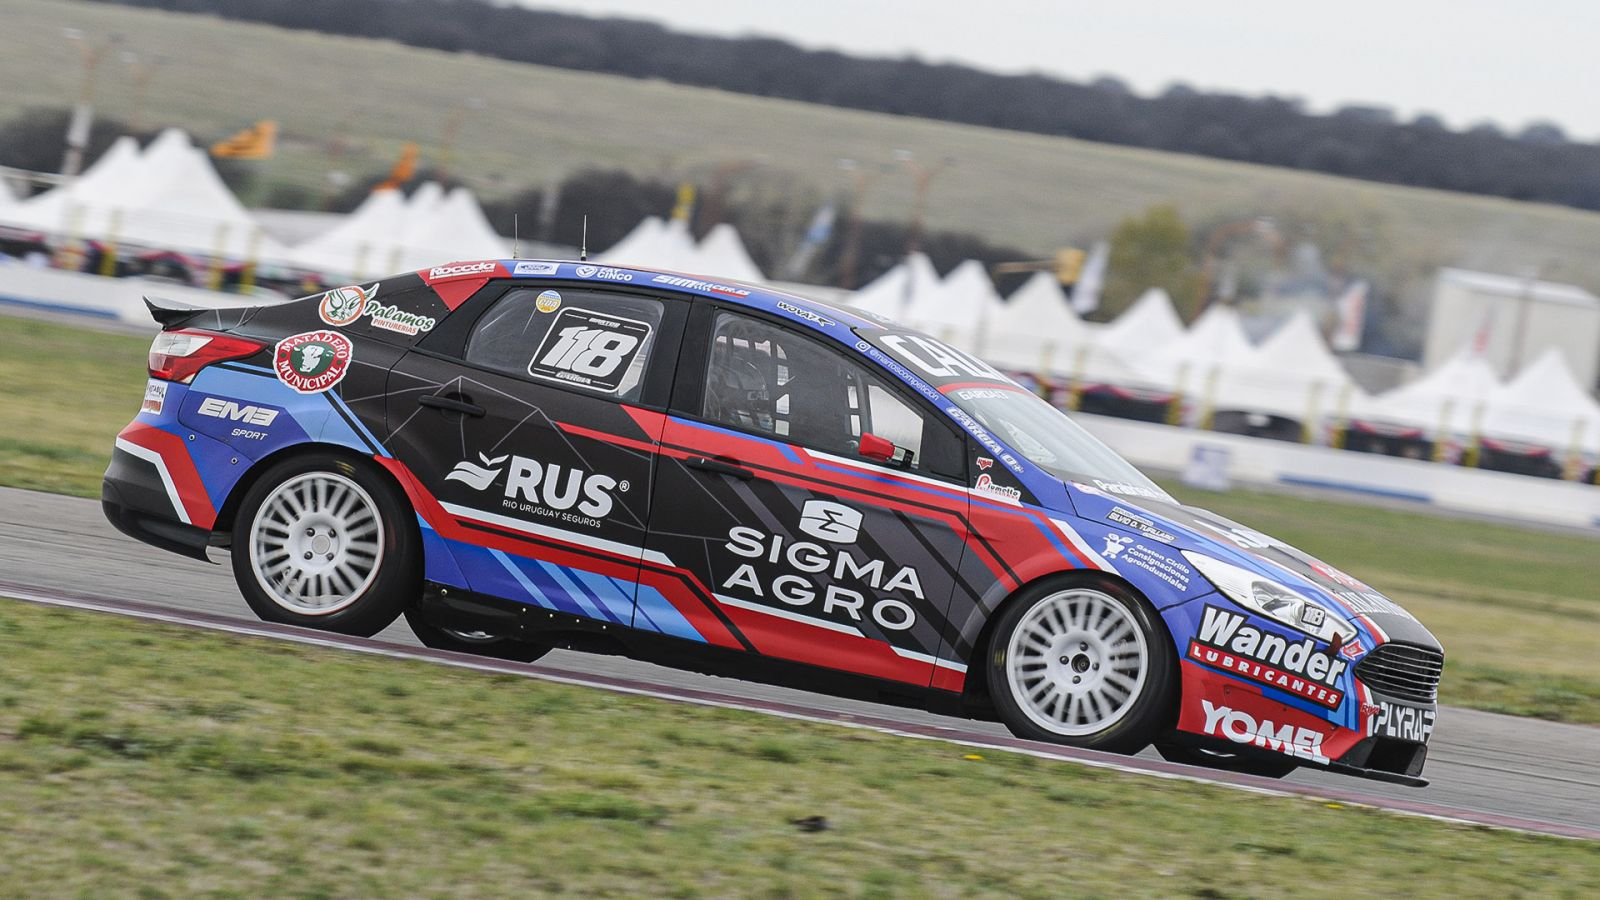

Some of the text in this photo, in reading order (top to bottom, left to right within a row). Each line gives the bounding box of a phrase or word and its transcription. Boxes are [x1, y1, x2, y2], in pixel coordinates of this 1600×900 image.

[597, 273, 633, 281] CINCO
[365, 302, 433, 330] Palamos
[373, 319, 417, 333] PINTURERIAS
[281, 333, 348, 359] MATADERO
[540, 326, 638, 377] 118
[279, 360, 342, 389] MUNICIPAL
[231, 428, 268, 440] SPORT
[503, 500, 601, 528] RIO URUGUAY SEGUROS
[725, 526, 924, 600] SIGMA
[1121, 554, 1187, 591] Agroindustriales
[1127, 547, 1189, 583] Consignaciones
[1136, 544, 1190, 574] Gaston Cirillo
[722, 564, 916, 630] AGRO
[1199, 606, 1346, 686] Wander
[1193, 646, 1338, 705] LUBRICANTES
[1201, 699, 1330, 765] YOMEL
